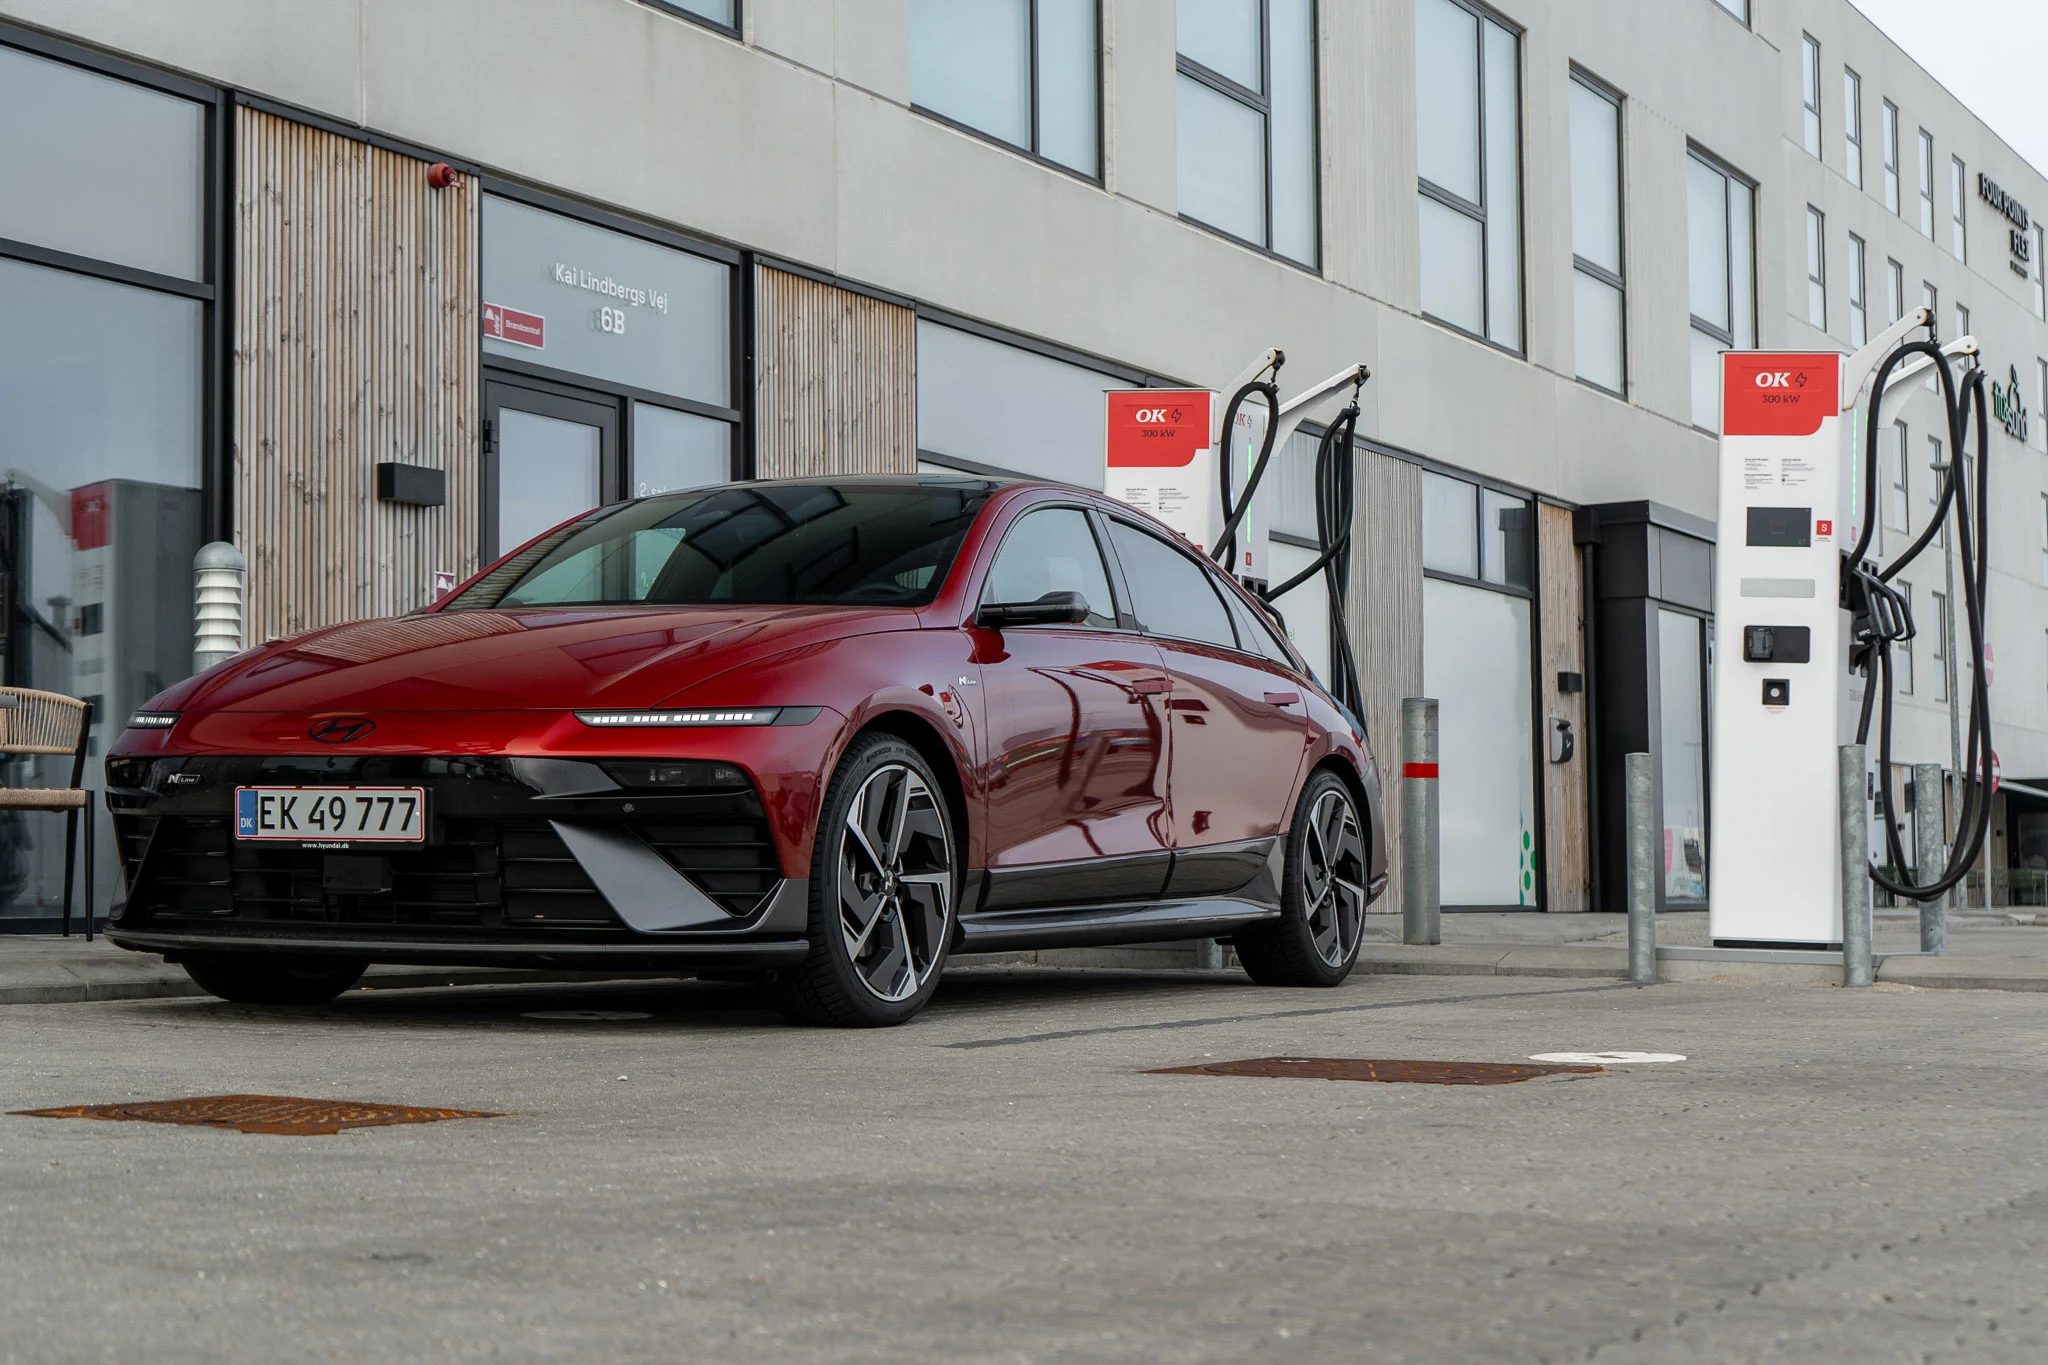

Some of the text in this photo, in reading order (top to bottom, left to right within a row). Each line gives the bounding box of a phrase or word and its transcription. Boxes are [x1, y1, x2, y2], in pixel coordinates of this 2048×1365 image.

[555, 262, 668, 315] Kai Lindbergs Vej
[505, 319, 541, 337] Brandcentral
[600, 306, 626, 335] 6B
[1755, 372, 1791, 388] OK
[1761, 394, 1801, 404] 300 kW
[1135, 408, 1167, 423] OK
[1141, 429, 1176, 438] 300 kW
[259, 795, 417, 832] EK 49 777
[240, 817, 253, 829] DK
[301, 842, 350, 850] www.hyundai.dk
